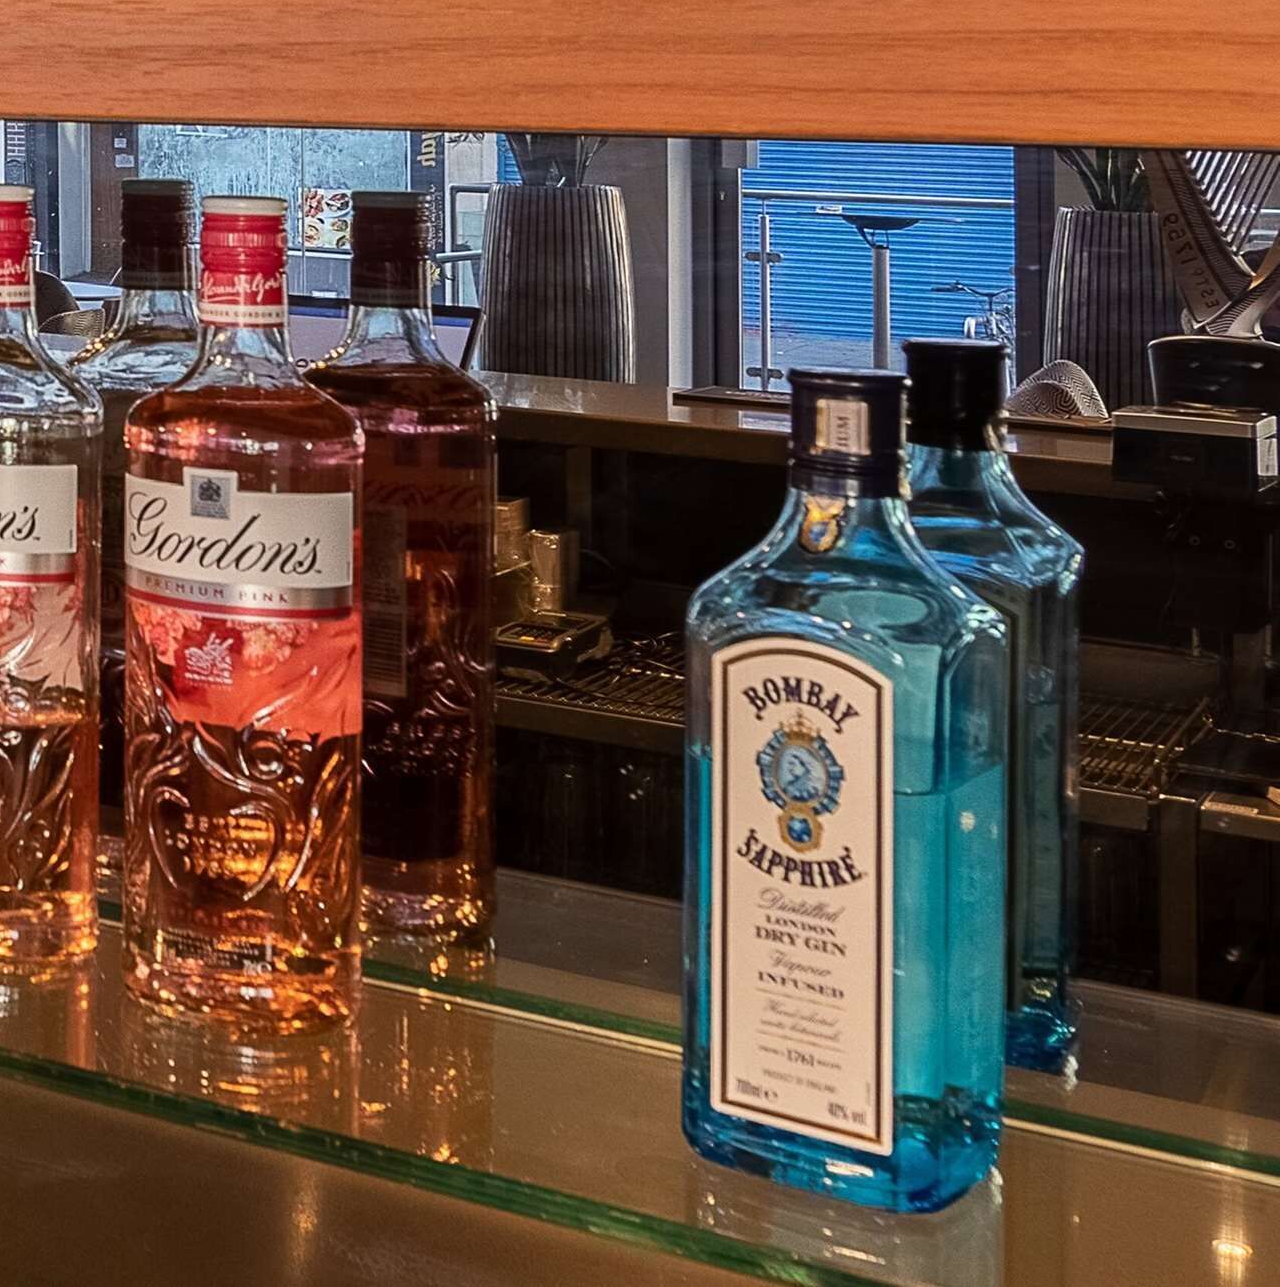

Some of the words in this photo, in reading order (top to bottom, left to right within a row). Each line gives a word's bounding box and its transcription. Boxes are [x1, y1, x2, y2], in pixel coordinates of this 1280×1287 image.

[128, 491, 321, 576] Gordon's
[144, 576, 225, 599] PREMIUM
[239, 592, 291, 605] PINK
[742, 675, 861, 735] BOMBAY
[736, 827, 863, 889] SAPPHIRE
[754, 924, 801, 948] DRY
[804, 935, 848, 958] GIN
[764, 913, 838, 938] LONDON
[756, 970, 846, 999] INFUSED
